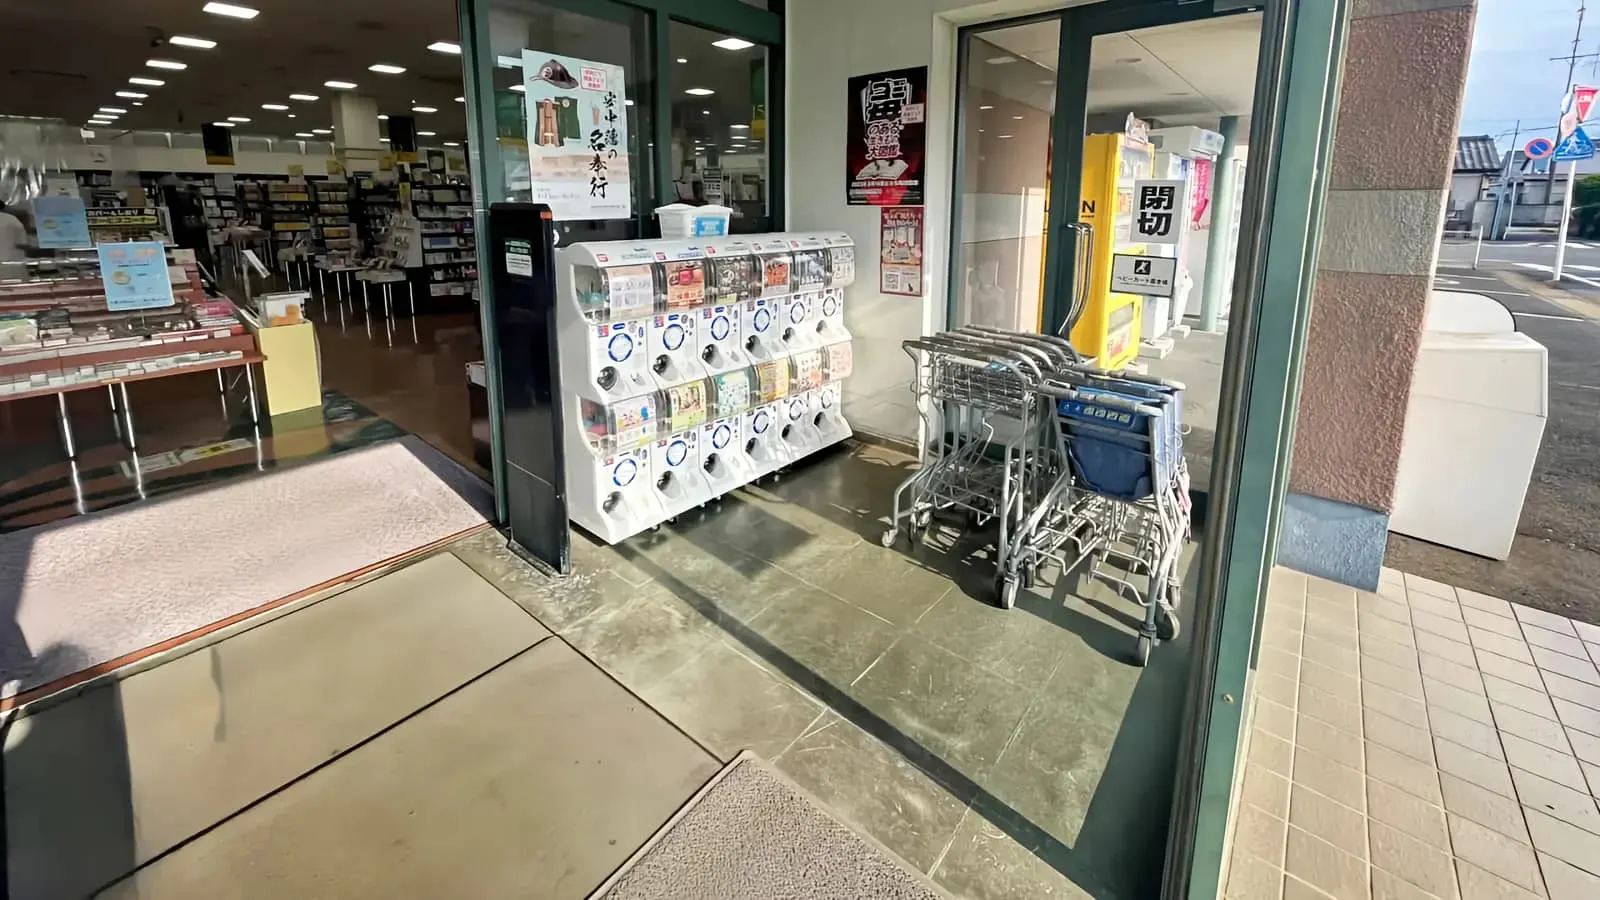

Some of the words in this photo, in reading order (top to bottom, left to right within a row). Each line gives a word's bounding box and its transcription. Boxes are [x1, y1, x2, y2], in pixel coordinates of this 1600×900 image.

[588, 129, 608, 199] 名奉行
[1137, 185, 1175, 236] 閉切
